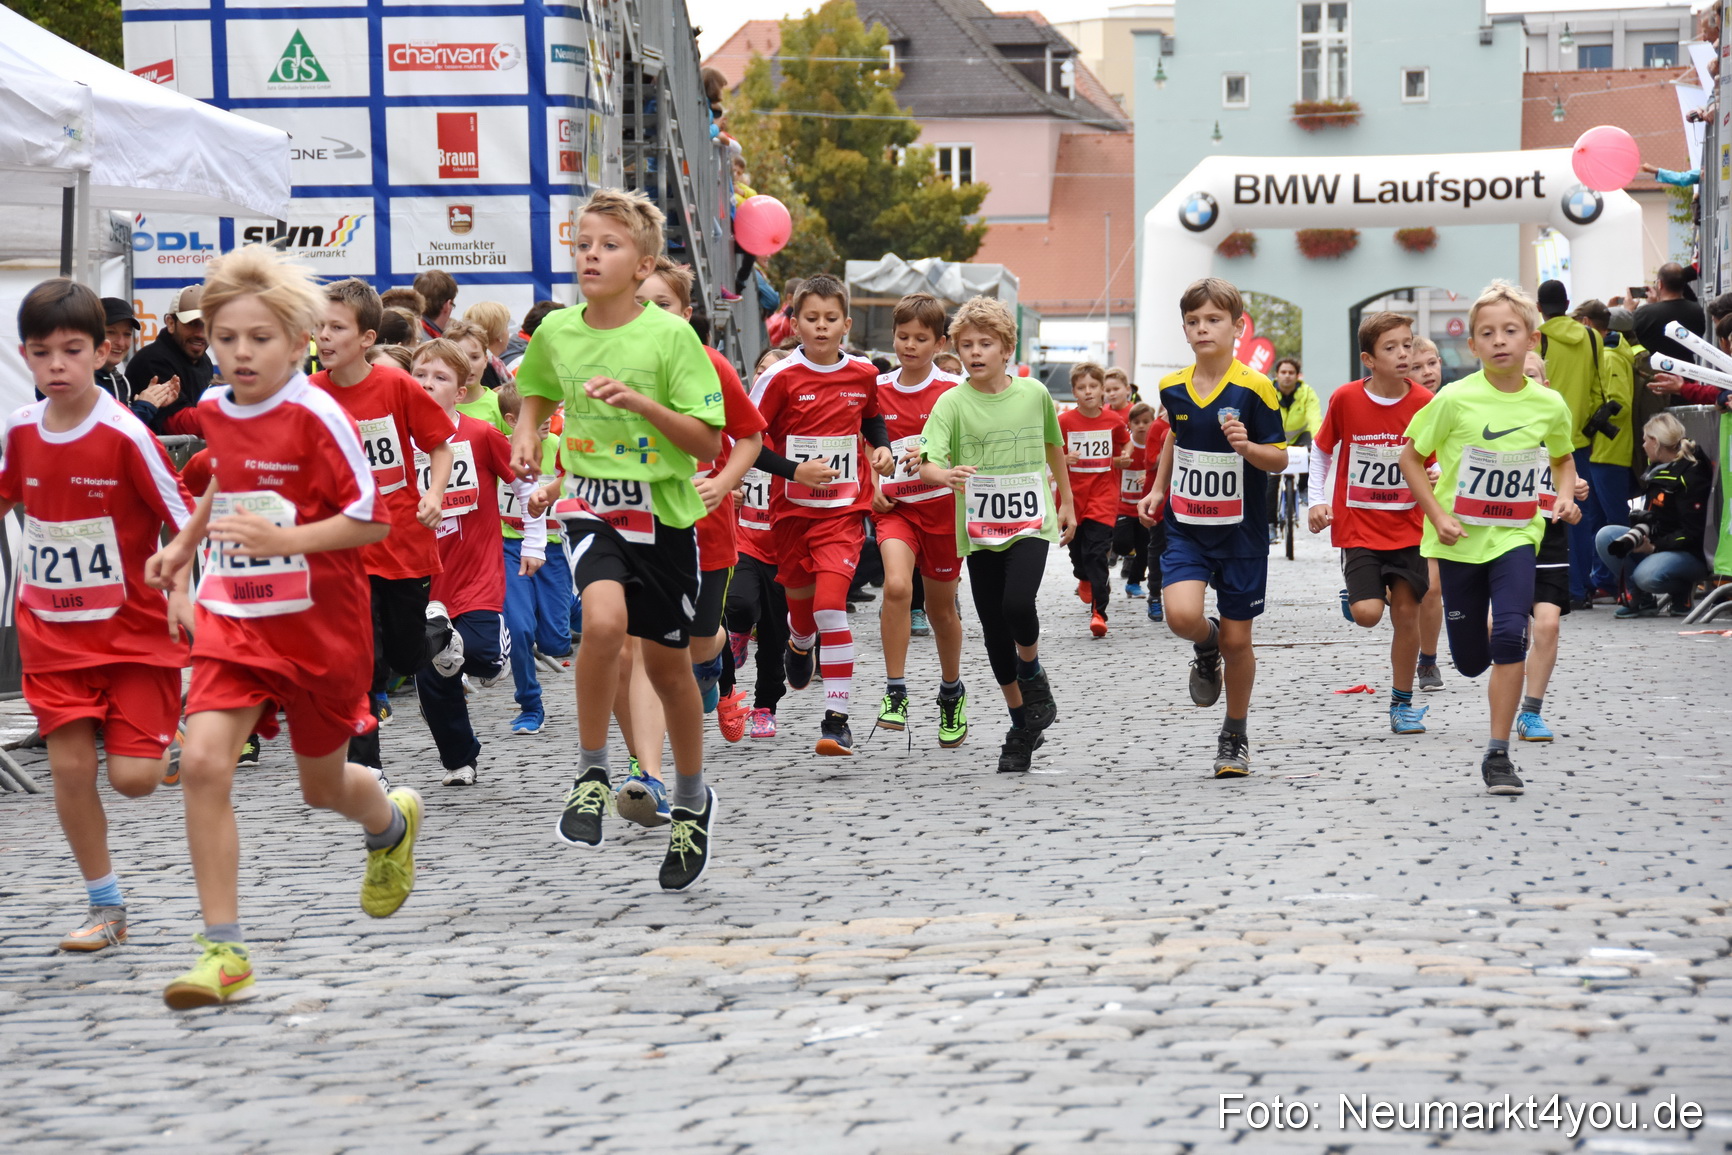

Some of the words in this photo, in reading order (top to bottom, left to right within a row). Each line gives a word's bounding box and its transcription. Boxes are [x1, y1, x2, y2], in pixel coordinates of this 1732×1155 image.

[393, 43, 485, 64] charivari
[438, 148, 476, 166] Braun
[1234, 174, 1341, 204] BMW
[1353, 170, 1545, 208] Laufsport
[430, 240, 495, 251] Neumarkter
[418, 251, 506, 265] Lammsbräu
[359, 421, 388, 434] OCK
[822, 438, 852, 448] BOCK
[1352, 432, 1398, 441] Neumarkter
[364, 437, 394, 467] 48
[566, 437, 595, 453] ERZ
[1073, 440, 1109, 456] 7128
[1198, 454, 1237, 465] BOCK
[1382, 449, 1401, 459] BO
[1469, 454, 1497, 464] NeuerMarkt
[1502, 451, 1536, 464] BOCK
[245, 459, 256, 469] FC
[258, 460, 299, 472] Holzheim
[795, 453, 849, 479] 41
[1357, 460, 1405, 485] 720
[84, 477, 118, 486] Holzheim
[257, 475, 284, 486] Julius
[1001, 476, 1037, 486] BOCK
[1126, 478, 1140, 490] 71
[1178, 466, 1237, 497] 7000
[1468, 466, 1535, 498] 7084
[88, 490, 104, 498] Luis
[574, 474, 643, 506] 7069
[743, 483, 770, 505] 71
[1370, 491, 1399, 501] Jakob
[974, 490, 1038, 519] 7059
[1186, 502, 1219, 515] Niklas
[1482, 504, 1513, 516] Attila
[48, 522, 104, 538] BOCK
[28, 543, 112, 583] 7214
[299, 561, 304, 569] K
[233, 582, 274, 600] Julius
[52, 594, 84, 608] Luis
